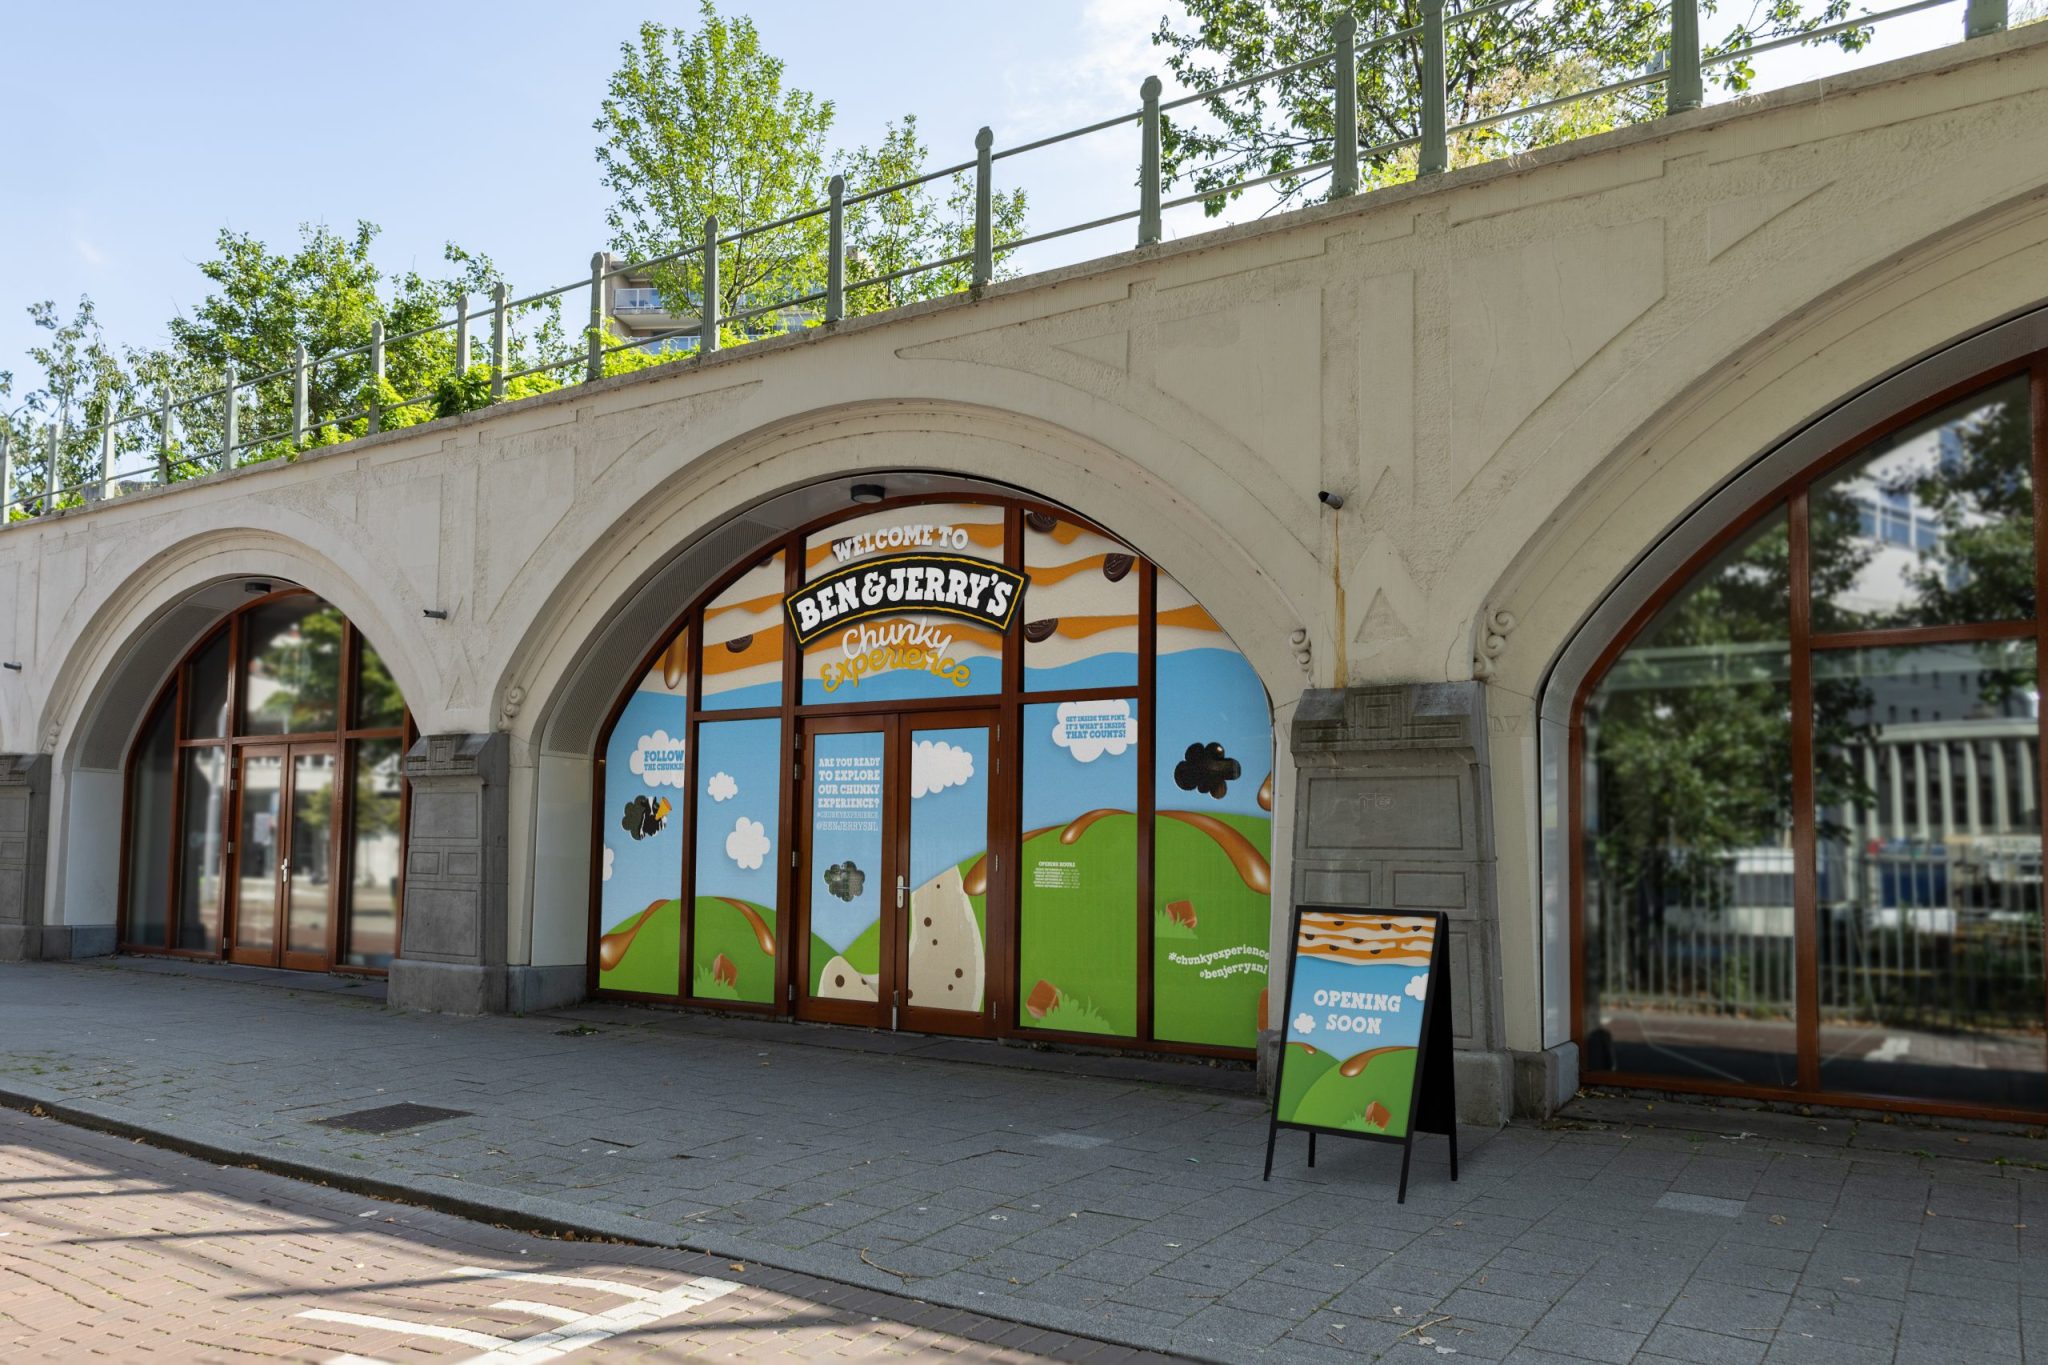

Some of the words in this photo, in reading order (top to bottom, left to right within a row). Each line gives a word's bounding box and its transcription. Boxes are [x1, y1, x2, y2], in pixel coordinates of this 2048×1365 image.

[833, 525, 933, 562] WELCOME
[938, 527, 968, 550] TO
[842, 617, 952, 663] Chunky
[820, 646, 970, 692] Experience
[1066, 731, 1088, 739] THAT
[1090, 730, 1126, 738] COUNTS!
[644, 750, 684, 762] FOLLOW
[819, 758, 834, 767] ARE
[836, 758, 852, 766] YOU
[854, 758, 880, 766] READY
[819, 771, 832, 780] TO
[834, 770, 880, 780] EXPLORE
[818, 785, 838, 794] OUR
[840, 784, 880, 794] CHUNKY
[818, 798, 880, 808] EXPERIENCE?
[1168, 944, 1270, 965] #chunkyexperience
[1314, 990, 1401, 1013] OPENING
[1326, 1014, 1383, 1035] SOON
